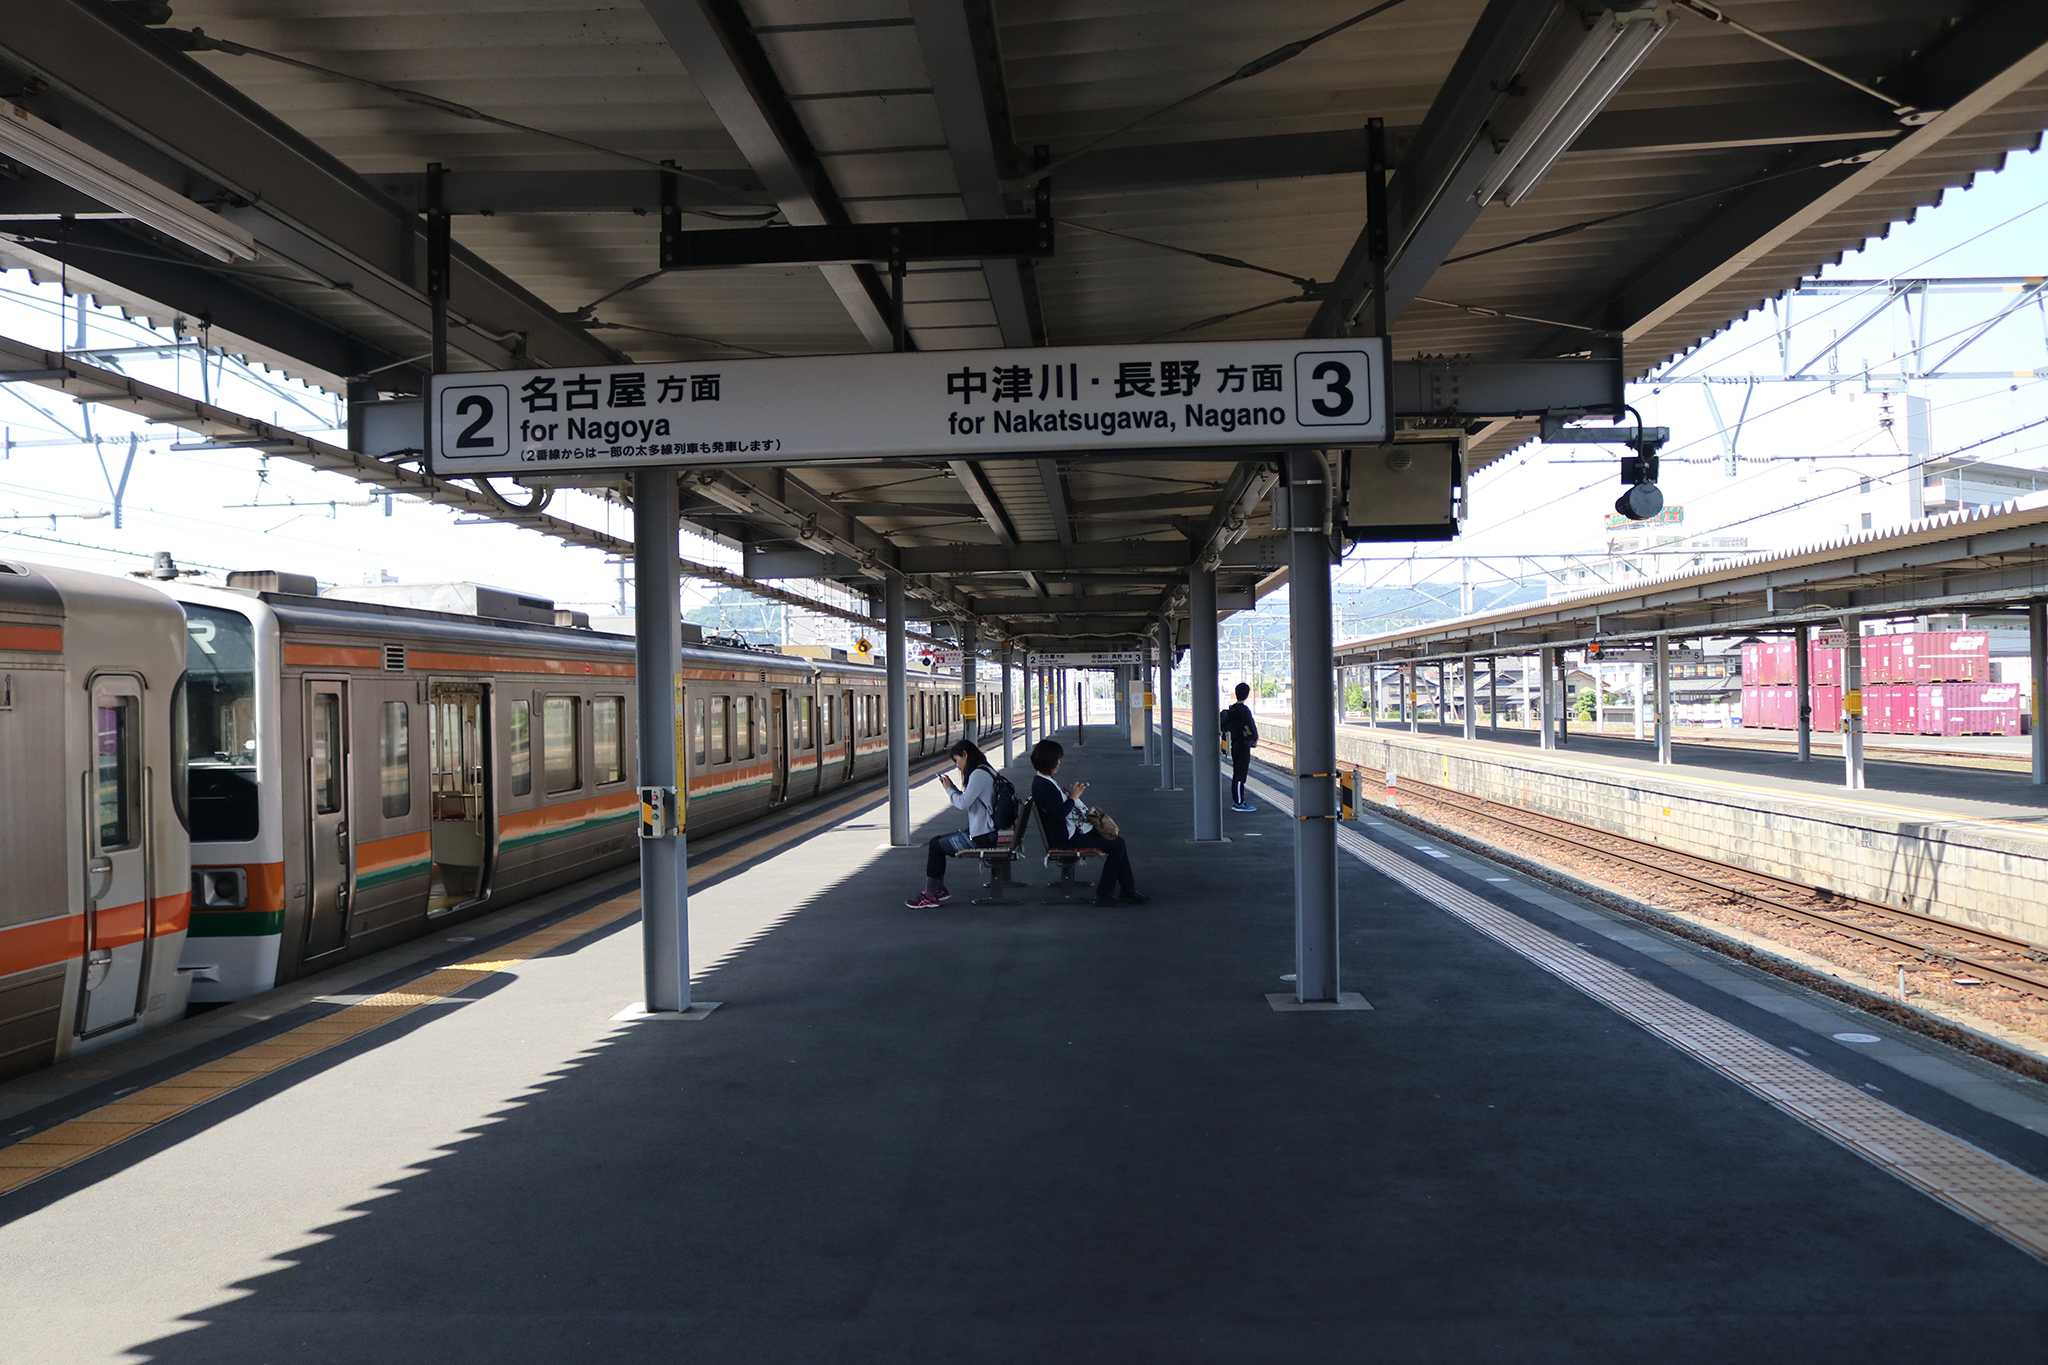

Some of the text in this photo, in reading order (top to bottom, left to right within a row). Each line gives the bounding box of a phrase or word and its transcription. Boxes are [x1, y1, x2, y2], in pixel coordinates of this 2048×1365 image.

[520, 372, 721, 414] 名古屋 方面
[947, 360, 1283, 405] 中津川・長野 方面
[1311, 360, 1354, 418] 3
[455, 394, 494, 449] 2
[520, 417, 671, 444] for Nagoya
[948, 403, 1286, 436] for Nakatsugawa, Nagano
